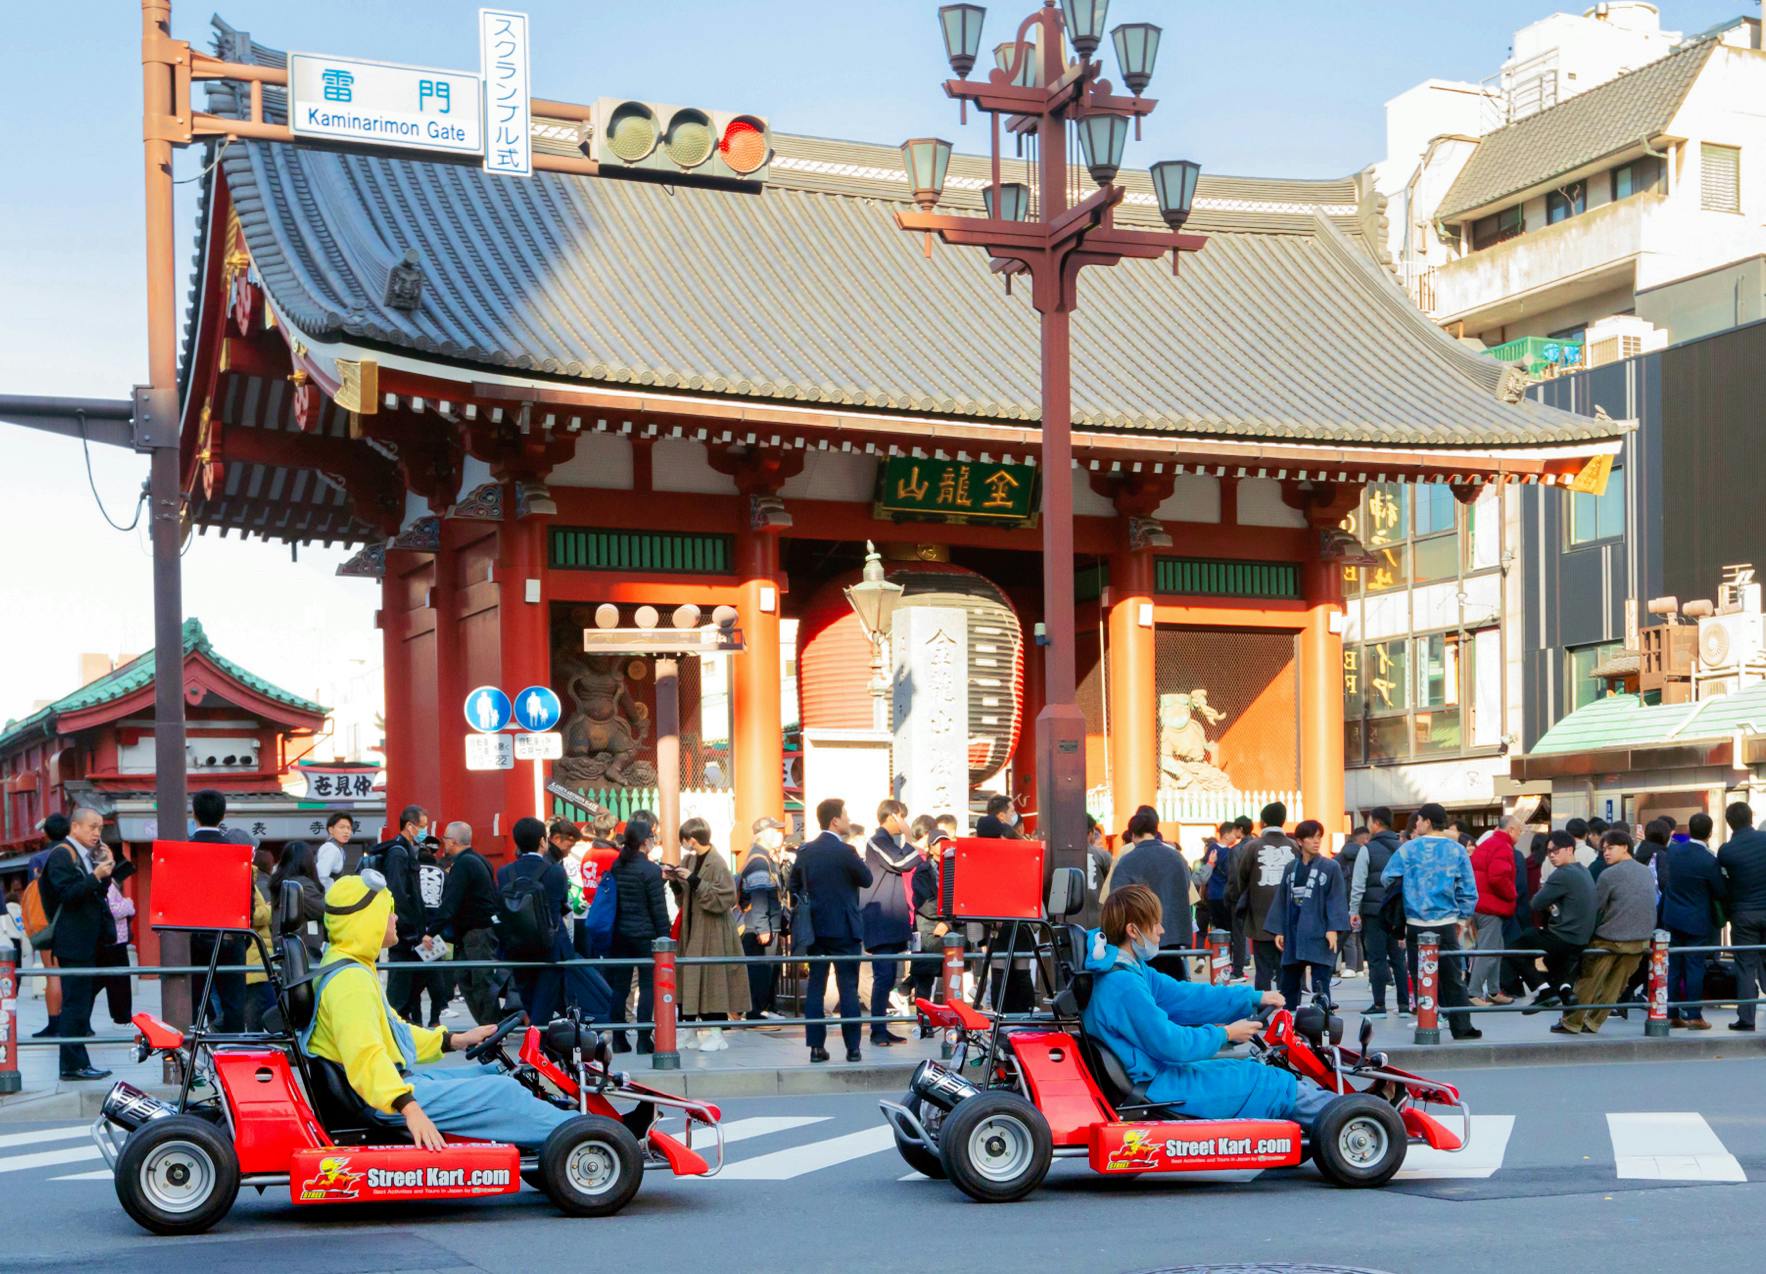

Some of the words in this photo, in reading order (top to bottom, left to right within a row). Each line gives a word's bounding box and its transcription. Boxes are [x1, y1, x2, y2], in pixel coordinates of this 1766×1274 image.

[308, 108, 420, 137] Kaminarimon
[427, 121, 466, 142] Gate
[1165, 1139, 1216, 1157] Street
[1218, 1137, 1252, 1155] Kart
[367, 1167, 423, 1187] Street
[427, 1167, 465, 1187] Kart
